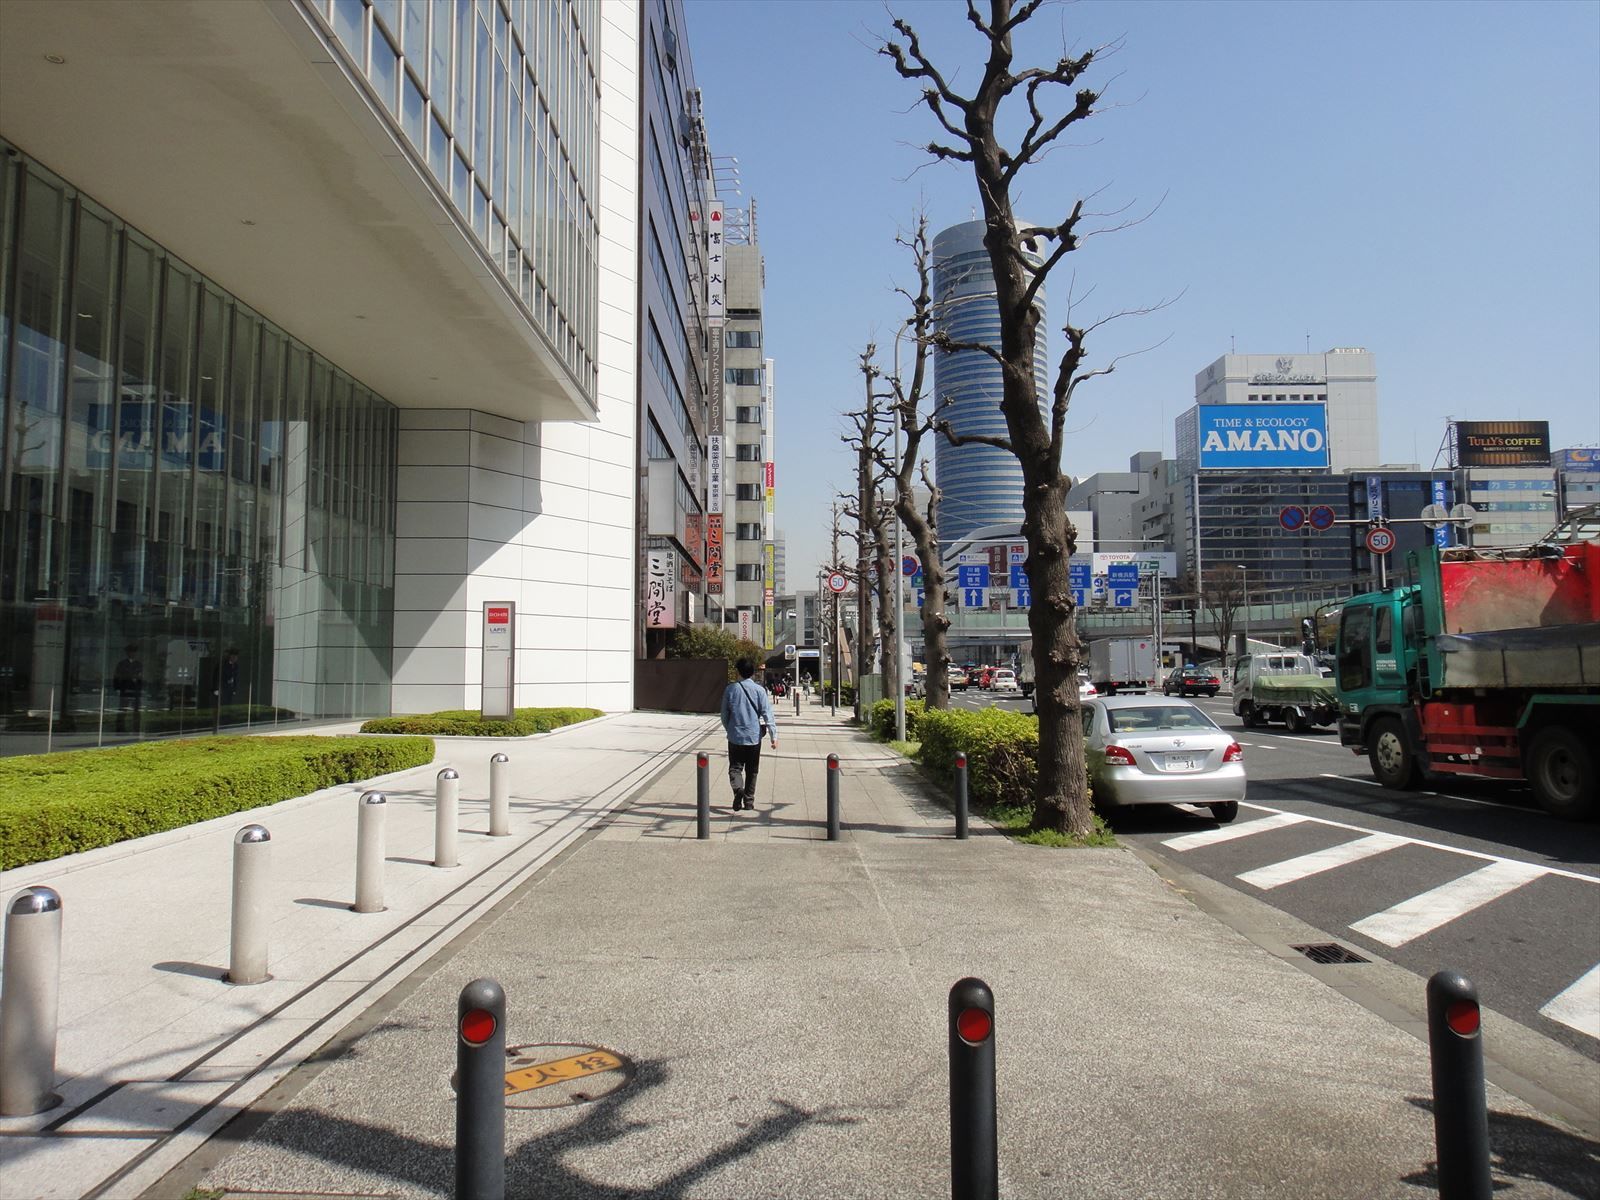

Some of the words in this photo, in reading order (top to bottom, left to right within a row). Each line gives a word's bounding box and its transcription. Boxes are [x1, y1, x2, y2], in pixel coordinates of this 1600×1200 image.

[1213, 418, 1241, 428] TIME
[1244, 418, 1254, 428] &
[1256, 417, 1310, 428] ECOLOGY
[1202, 429, 1323, 452] AMANO
[1504, 437, 1542, 446] COFFEE
[1373, 535, 1389, 546] 50
[832, 577, 843, 587] 50
[1184, 760, 1195, 769] 34
[505, 1055, 615, 1092] 火栓
